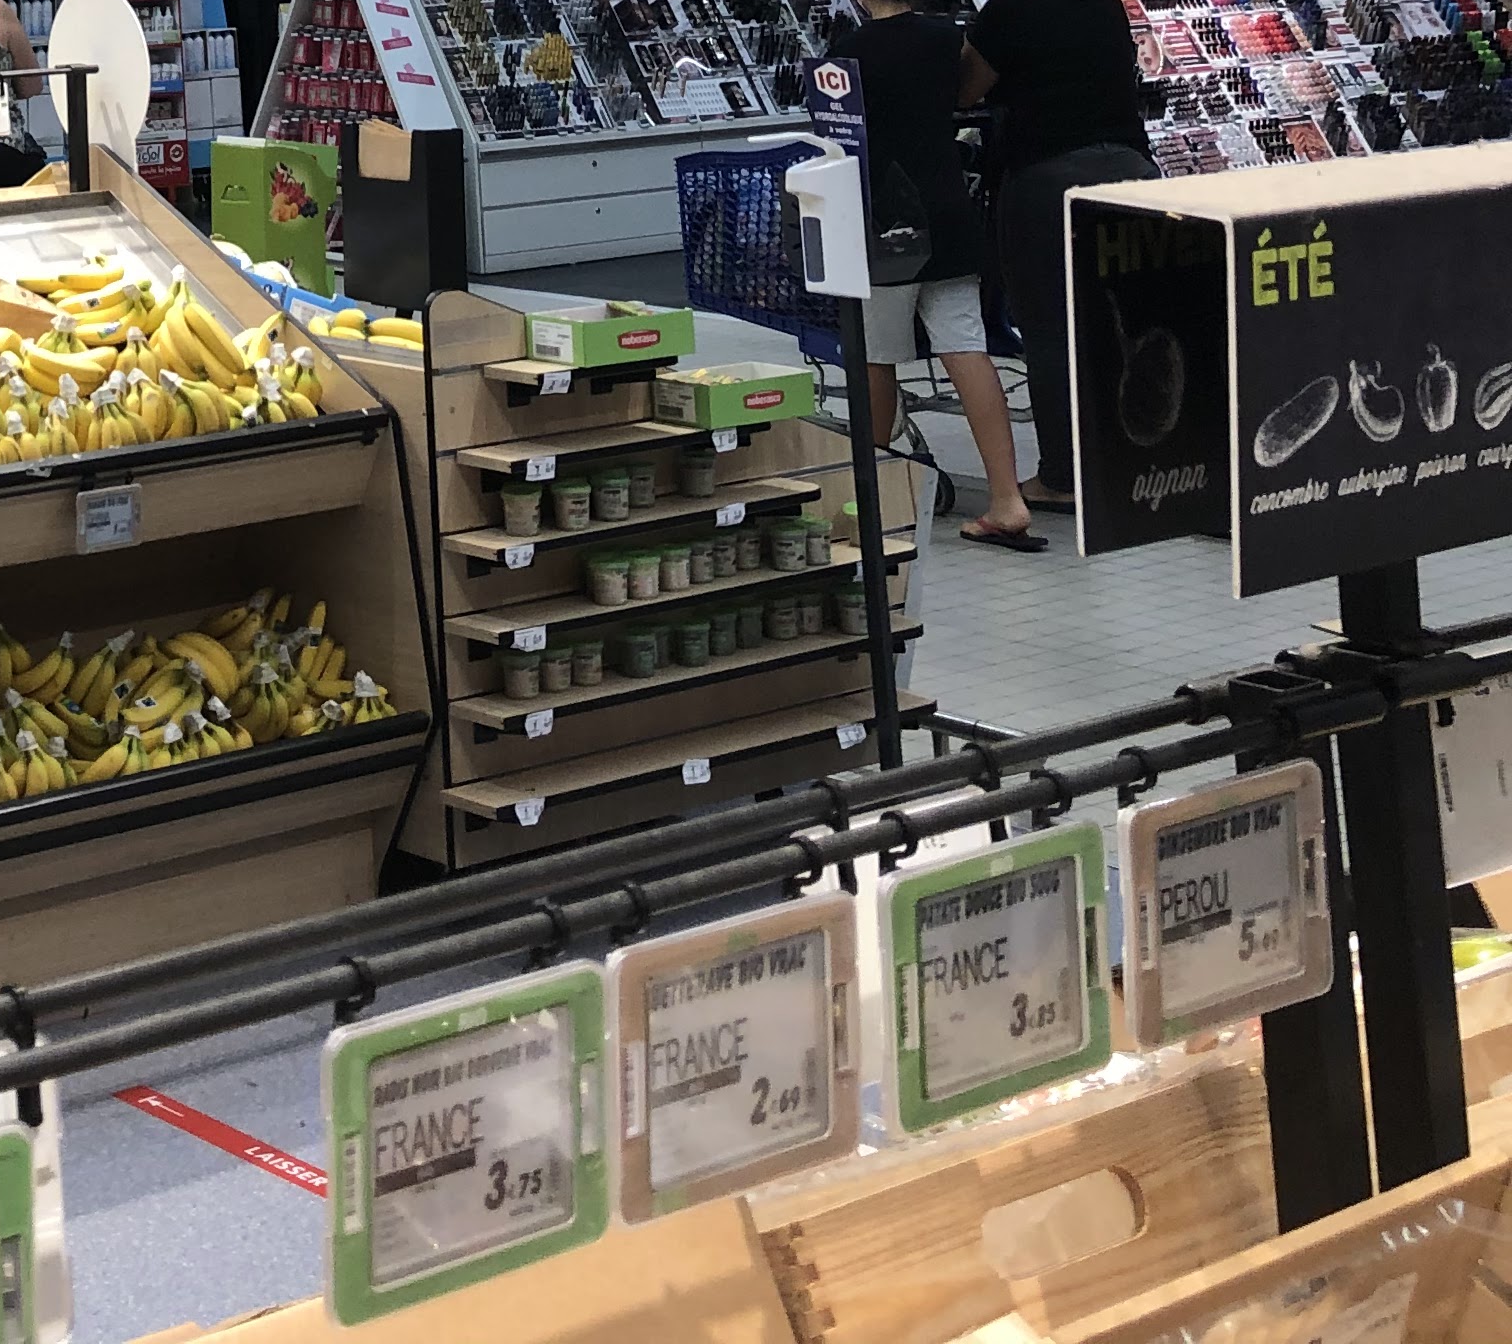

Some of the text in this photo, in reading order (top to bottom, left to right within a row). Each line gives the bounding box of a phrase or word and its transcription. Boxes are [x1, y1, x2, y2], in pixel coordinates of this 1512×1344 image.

[818, 71, 847, 91] ICI
[136, 145, 161, 164] icSol
[1251, 219, 1336, 307] ÉTÉ
[1131, 462, 1209, 511] oignon
[1249, 478, 1330, 516] concombre
[1337, 463, 1408, 497] aubergine
[1413, 453, 1468, 488] poivron
[1160, 868, 1229, 928] PEROU
[768, 941, 808, 980] VRAC
[921, 936, 1010, 998] FRANCE
[650, 1016, 749, 1086] FRANCE
[375, 1095, 486, 1175] FRANCE
[242, 1145, 329, 1188] LAISSER
